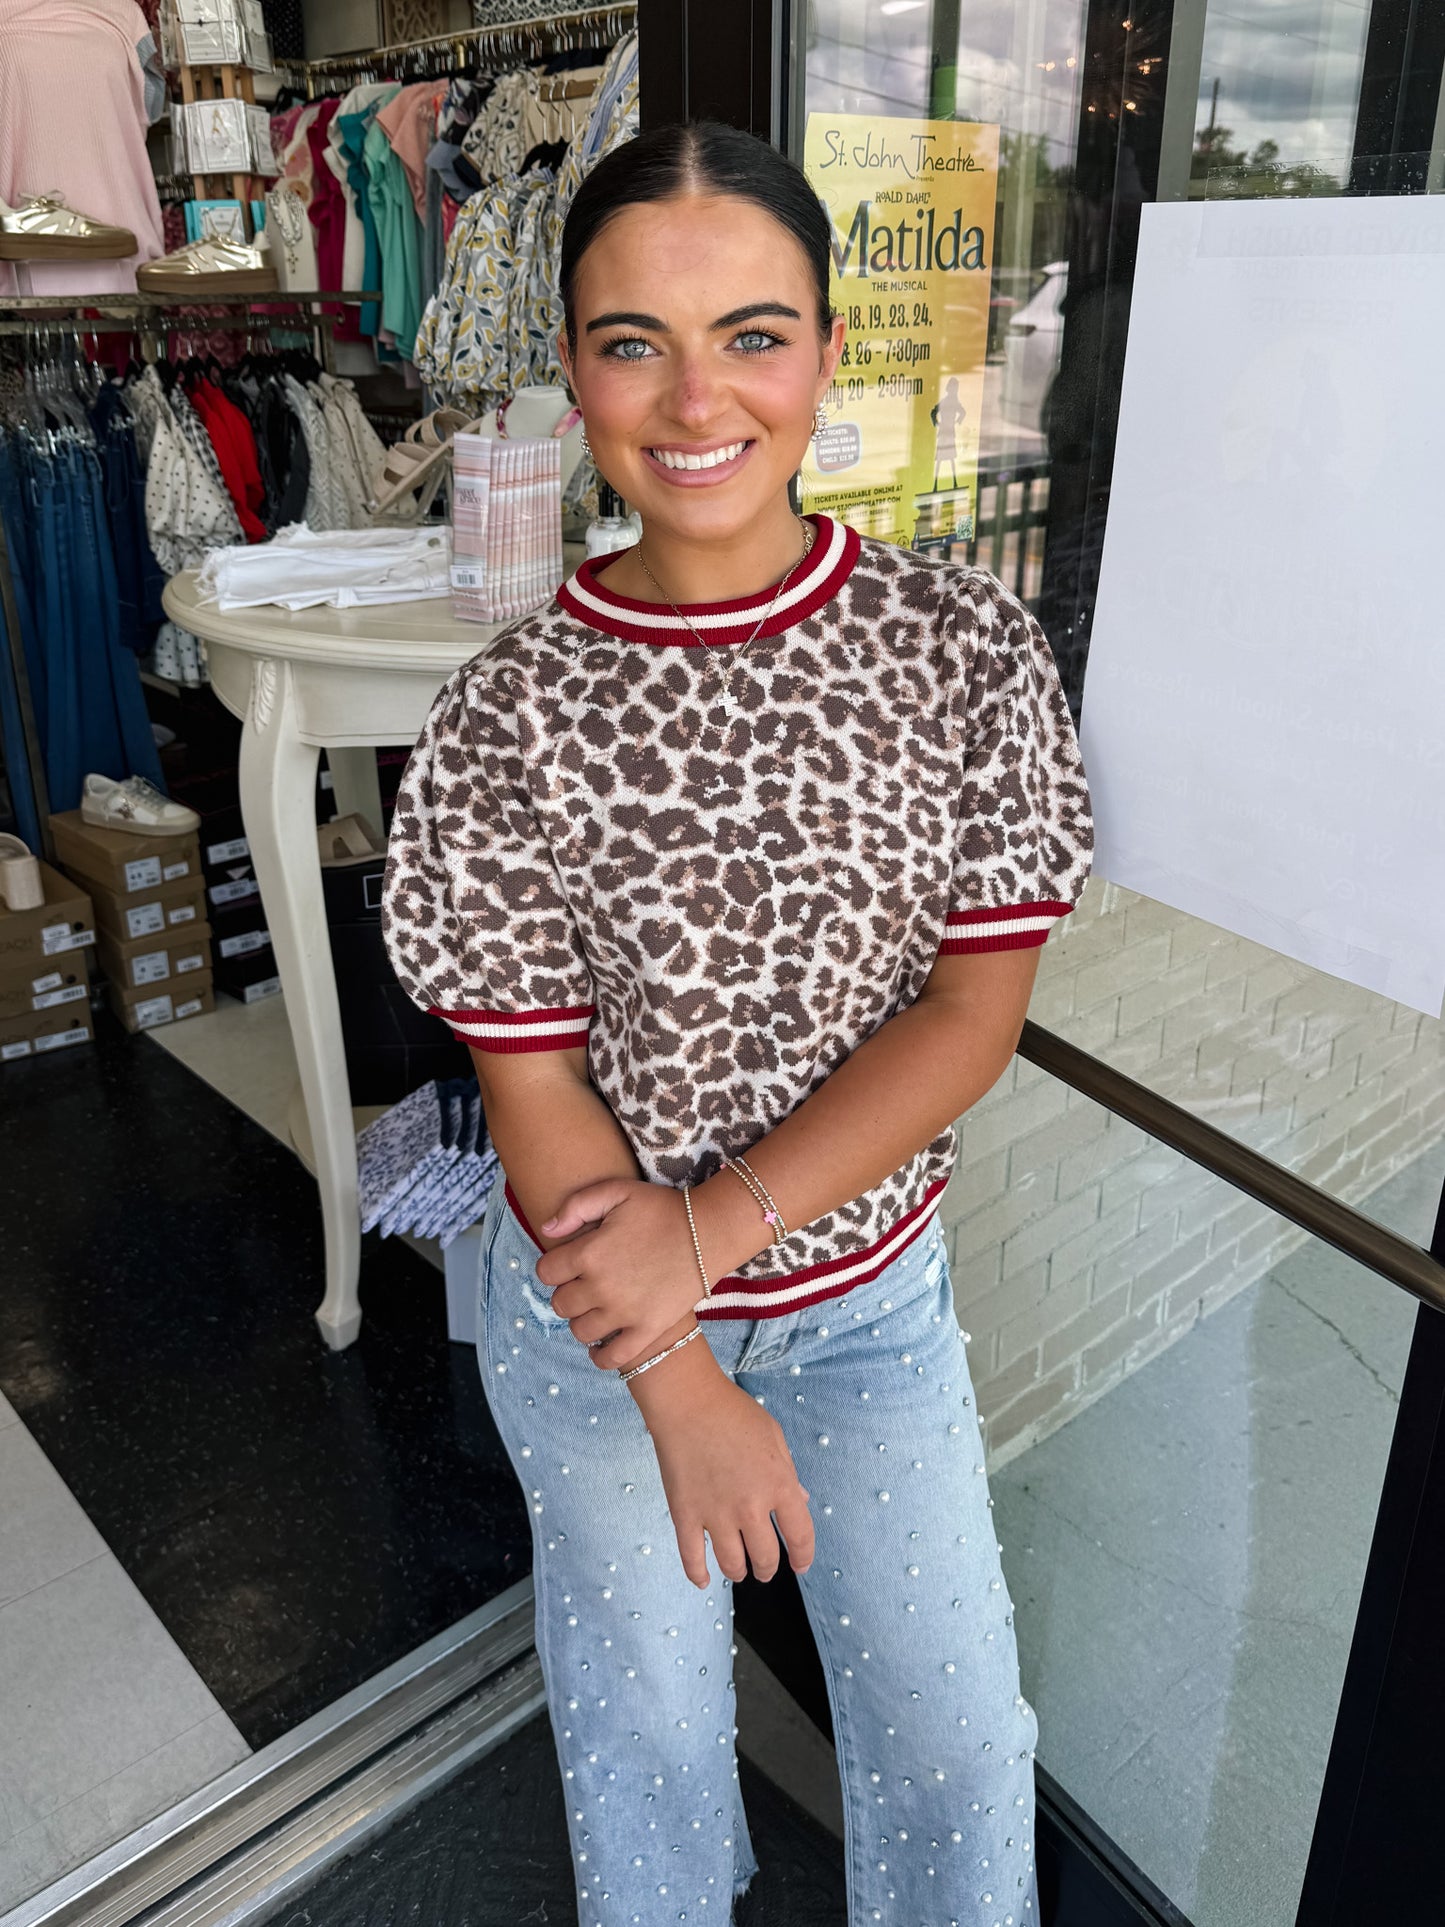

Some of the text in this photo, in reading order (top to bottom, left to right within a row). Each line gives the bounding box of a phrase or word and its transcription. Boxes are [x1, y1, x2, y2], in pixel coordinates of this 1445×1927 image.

[820, 130, 985, 180] St. John Theatre
[875, 191, 903, 204] ROALD
[820, 199, 987, 279] Matilda
[872, 281, 928, 292] THE MUSICAL
[841, 342, 851, 366] &
[856, 341, 872, 365] 26
[822, 379, 844, 410] uly
[848, 377, 864, 401] 20
[814, 484, 904, 504] TICKETS AVAILABLE ONLINE AT
